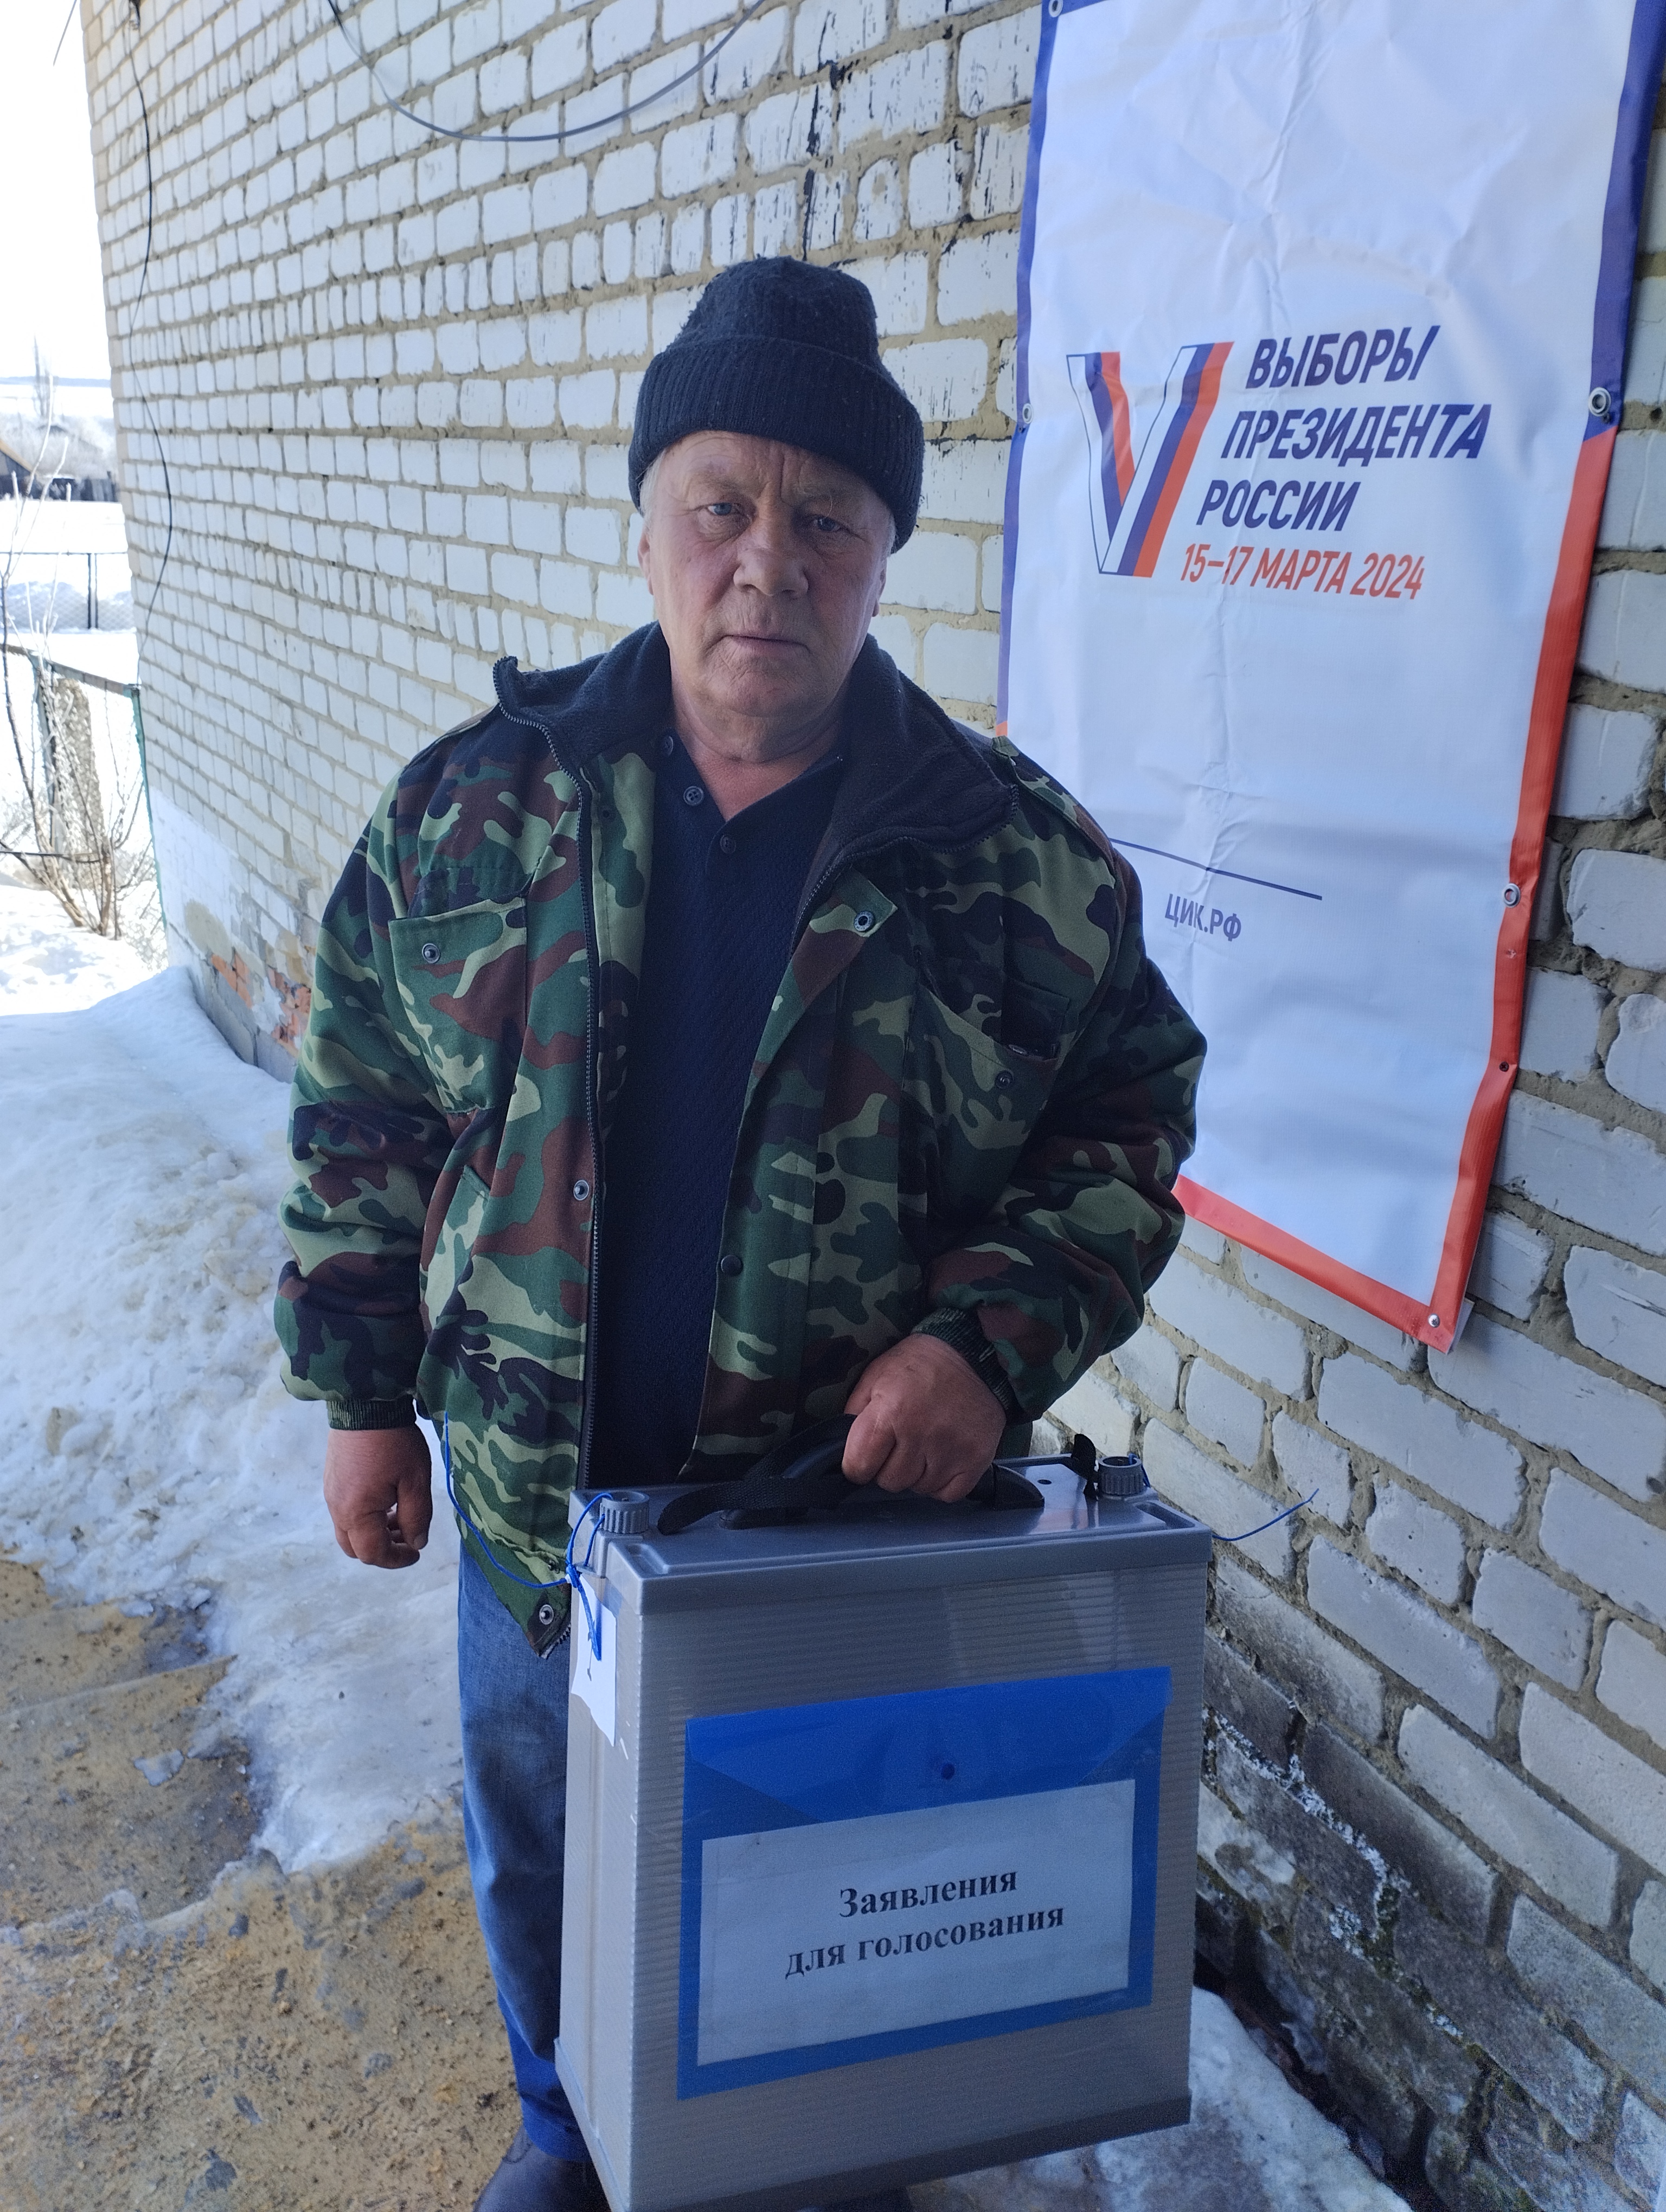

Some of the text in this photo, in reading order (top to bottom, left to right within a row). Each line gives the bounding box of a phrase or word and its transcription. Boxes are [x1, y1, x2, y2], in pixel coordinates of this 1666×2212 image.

[1246, 325, 1440, 389] ВЫБОРЫ
[1220, 404, 1492, 467] ПРЕЗИДЕНТА
[1196, 480, 1361, 531] РОССИИ
[1250, 548, 1352, 594] МАРТА
[1350, 553, 1425, 600] 2024
[1164, 893, 1242, 942] ЦИК.РФ
[839, 1870, 1017, 1918] Заявления
[785, 1907, 1065, 1980] для голосования
